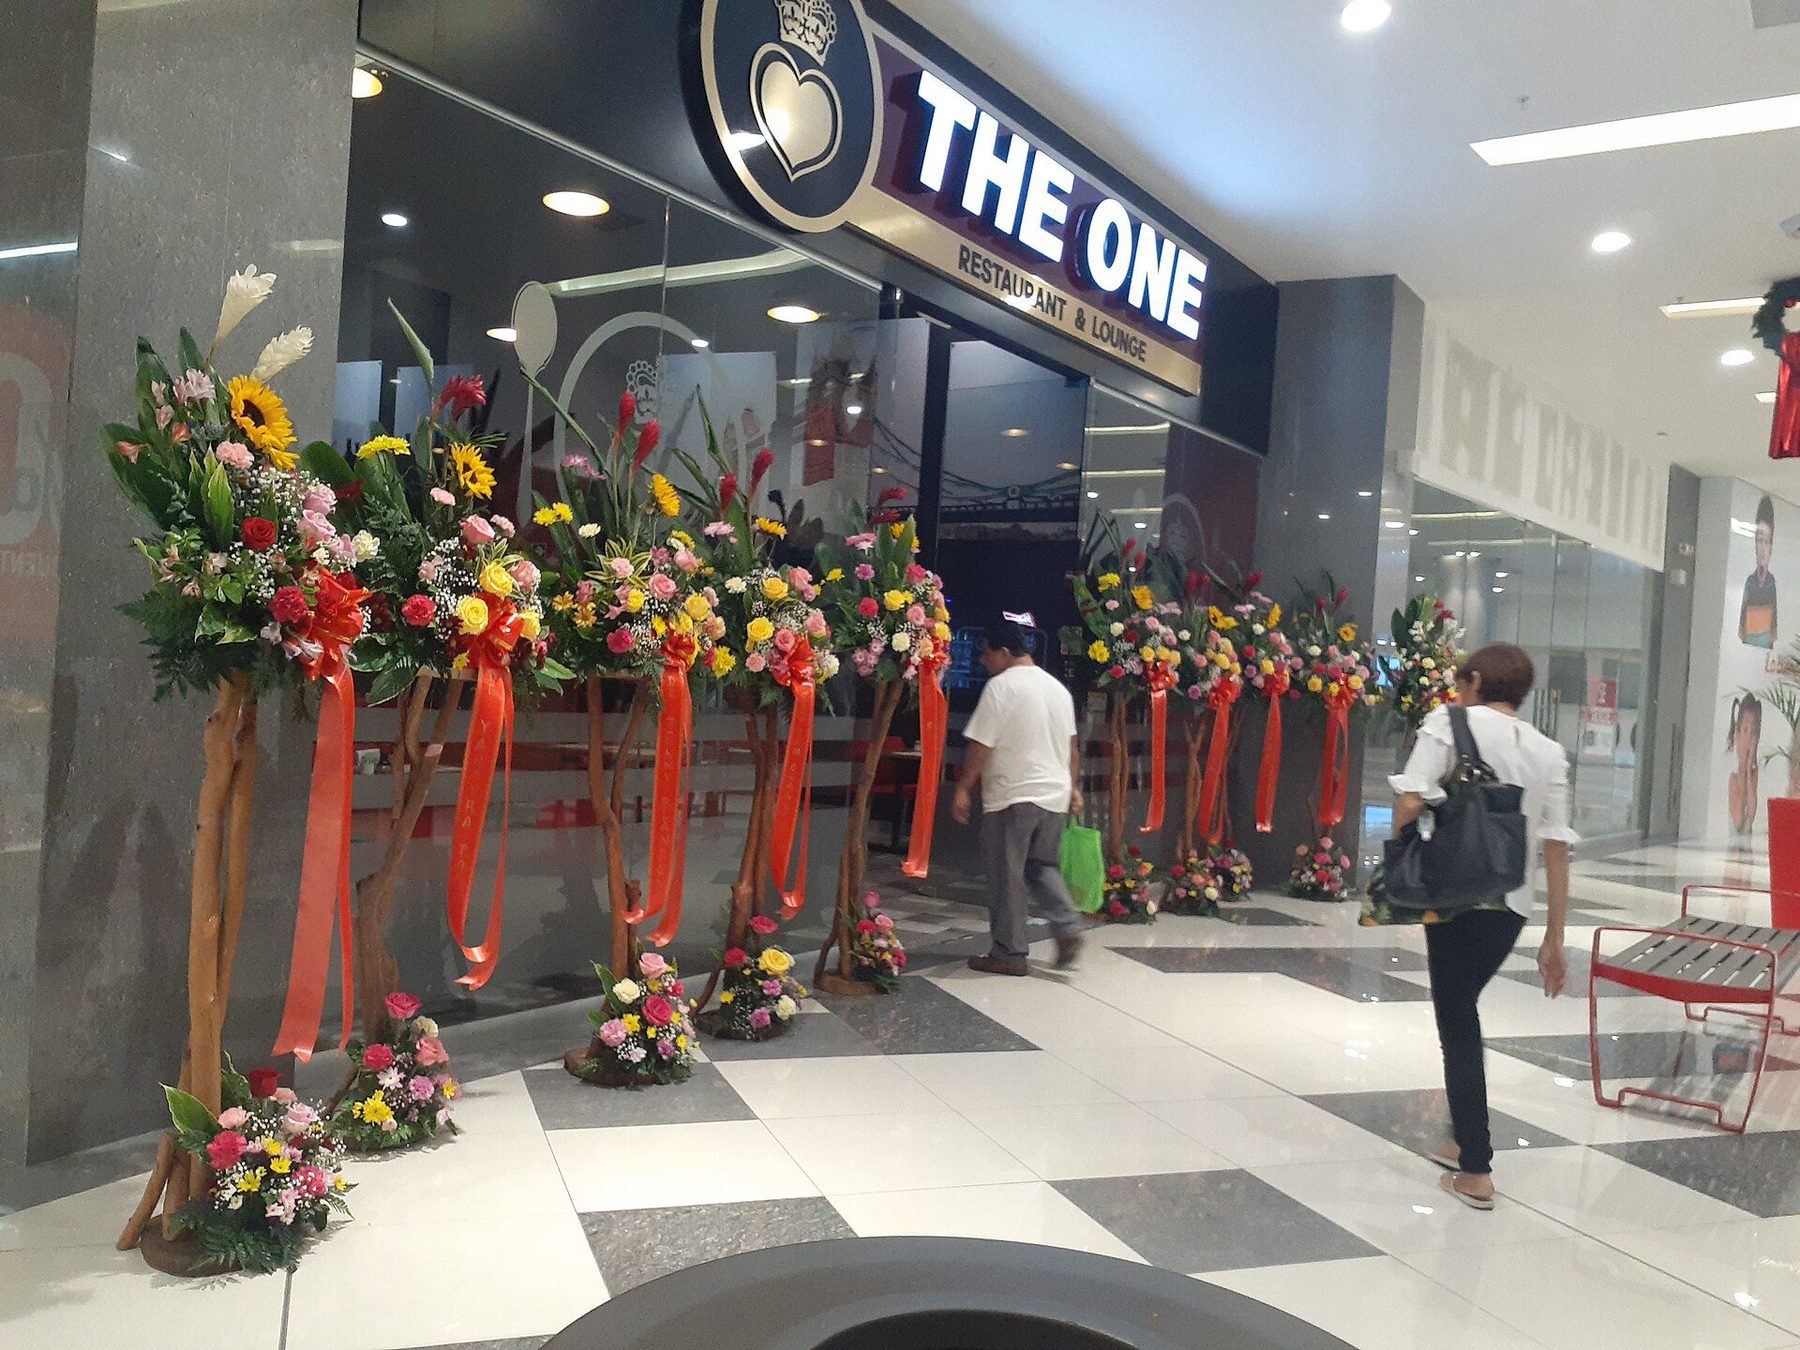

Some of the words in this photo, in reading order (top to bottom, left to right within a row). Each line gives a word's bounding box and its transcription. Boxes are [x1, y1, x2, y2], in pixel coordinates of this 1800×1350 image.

[918, 69, 1075, 263] THE
[1087, 198, 1208, 341] ONE
[1074, 307, 1086, 332] &
[1091, 315, 1147, 363] LOUNGE
